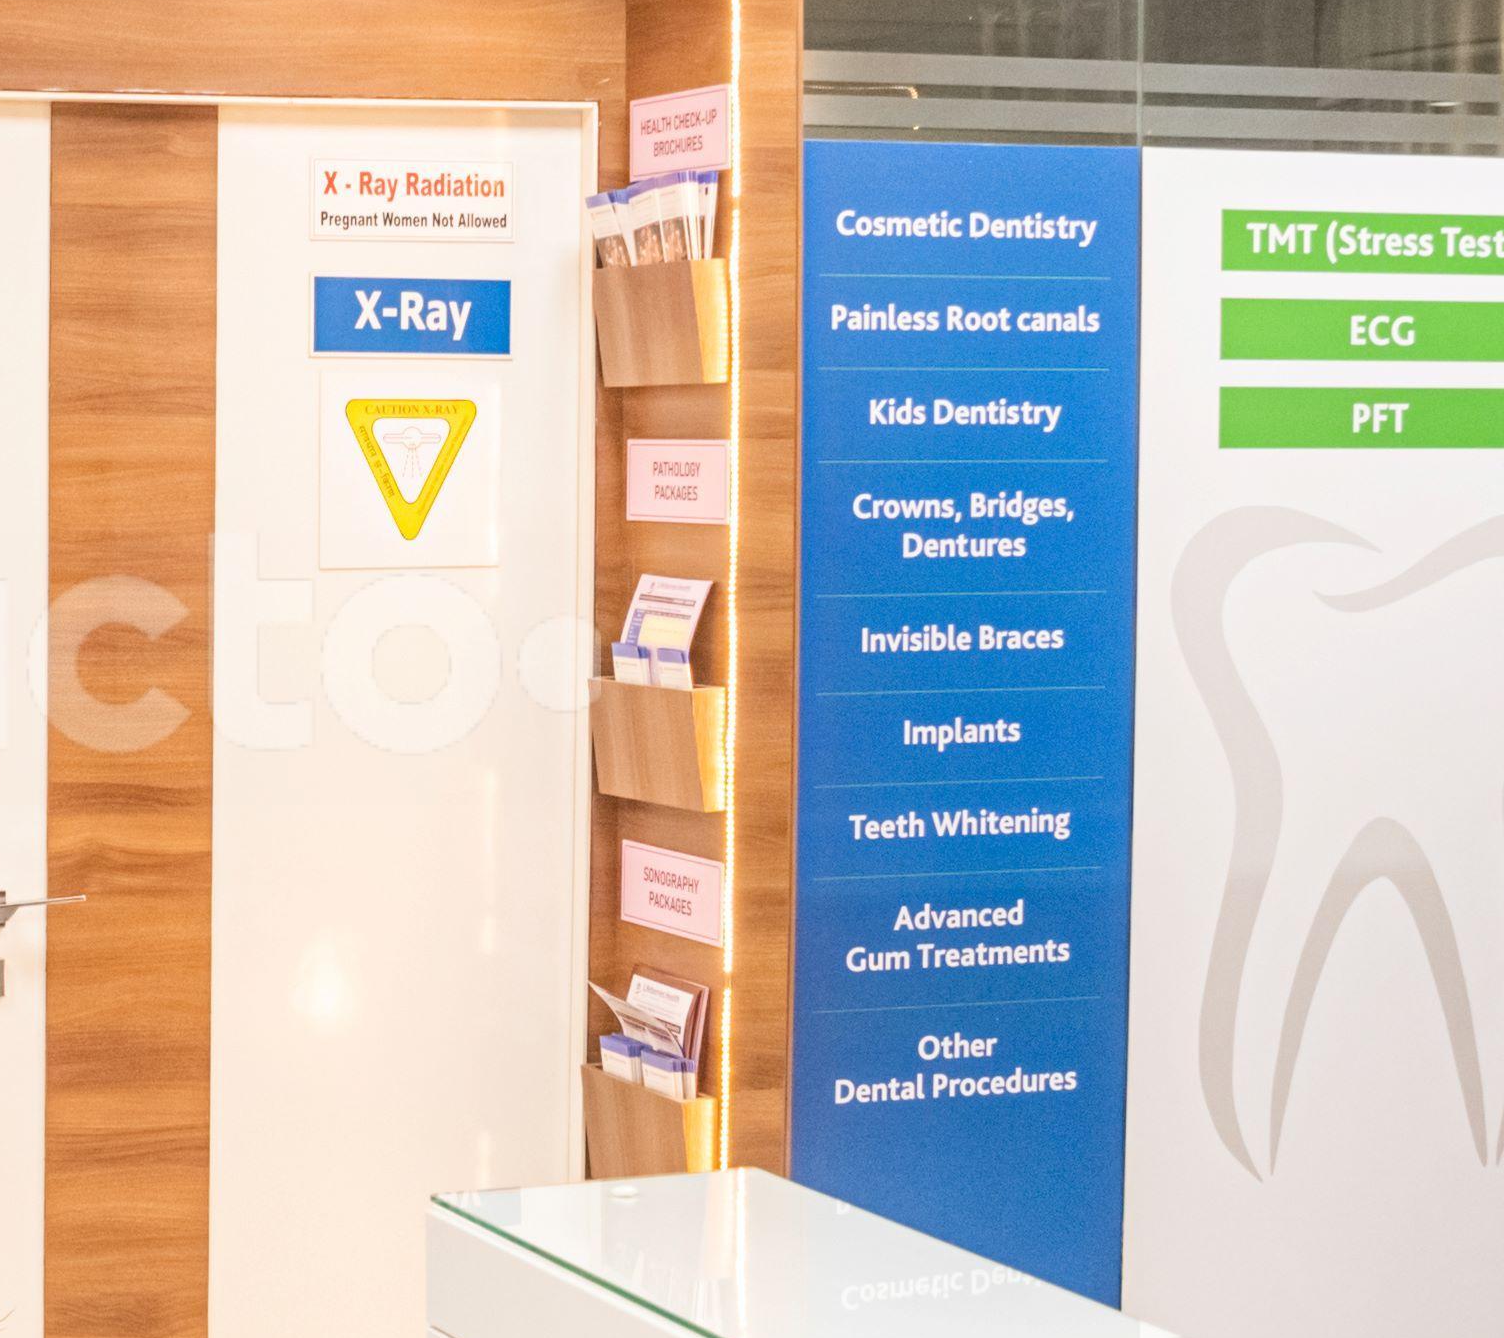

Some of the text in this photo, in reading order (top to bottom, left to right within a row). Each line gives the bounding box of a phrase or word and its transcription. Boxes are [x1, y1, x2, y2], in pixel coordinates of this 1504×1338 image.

[641, 109, 718, 136] HEALTH CHECK-UP
[653, 135, 703, 157] BROCHURES
[323, 170, 338, 195] X
[359, 171, 399, 203] Ray
[405, 171, 505, 198] Radiation
[320, 211, 507, 230] Pregnant Women Not Allowed
[836, 209, 1098, 248] Cosmetic Dentistry
[1245, 222, 1319, 255] TMT
[1325, 220, 1435, 265] (Stress
[354, 290, 472, 341] X-Ray
[831, 303, 1100, 333] Painless Root canals
[1349, 314, 1416, 347] ECG
[365, 404, 460, 415] CAUTION X-RAY
[869, 397, 1062, 433] Kids Dentistry
[1352, 402, 1410, 434] PFT
[652, 461, 701, 478] PATHOLOGY
[654, 484, 698, 501] PACKAGES
[852, 490, 1074, 526] Crowns, Bridges,
[902, 532, 1026, 558] Dentures
[861, 624, 1064, 653] Invisible Braces
[903, 716, 1021, 753] Implants
[848, 807, 1071, 840] Teeth Whitening
[643, 866, 700, 895] SONOGRAPHY
[648, 891, 693, 916] PACKAGES
[893, 899, 1024, 931] Advanced
[846, 939, 1070, 973] Gum Treatments
[917, 1032, 998, 1061] Other
[834, 1067, 1077, 1105] Dental Procedures
